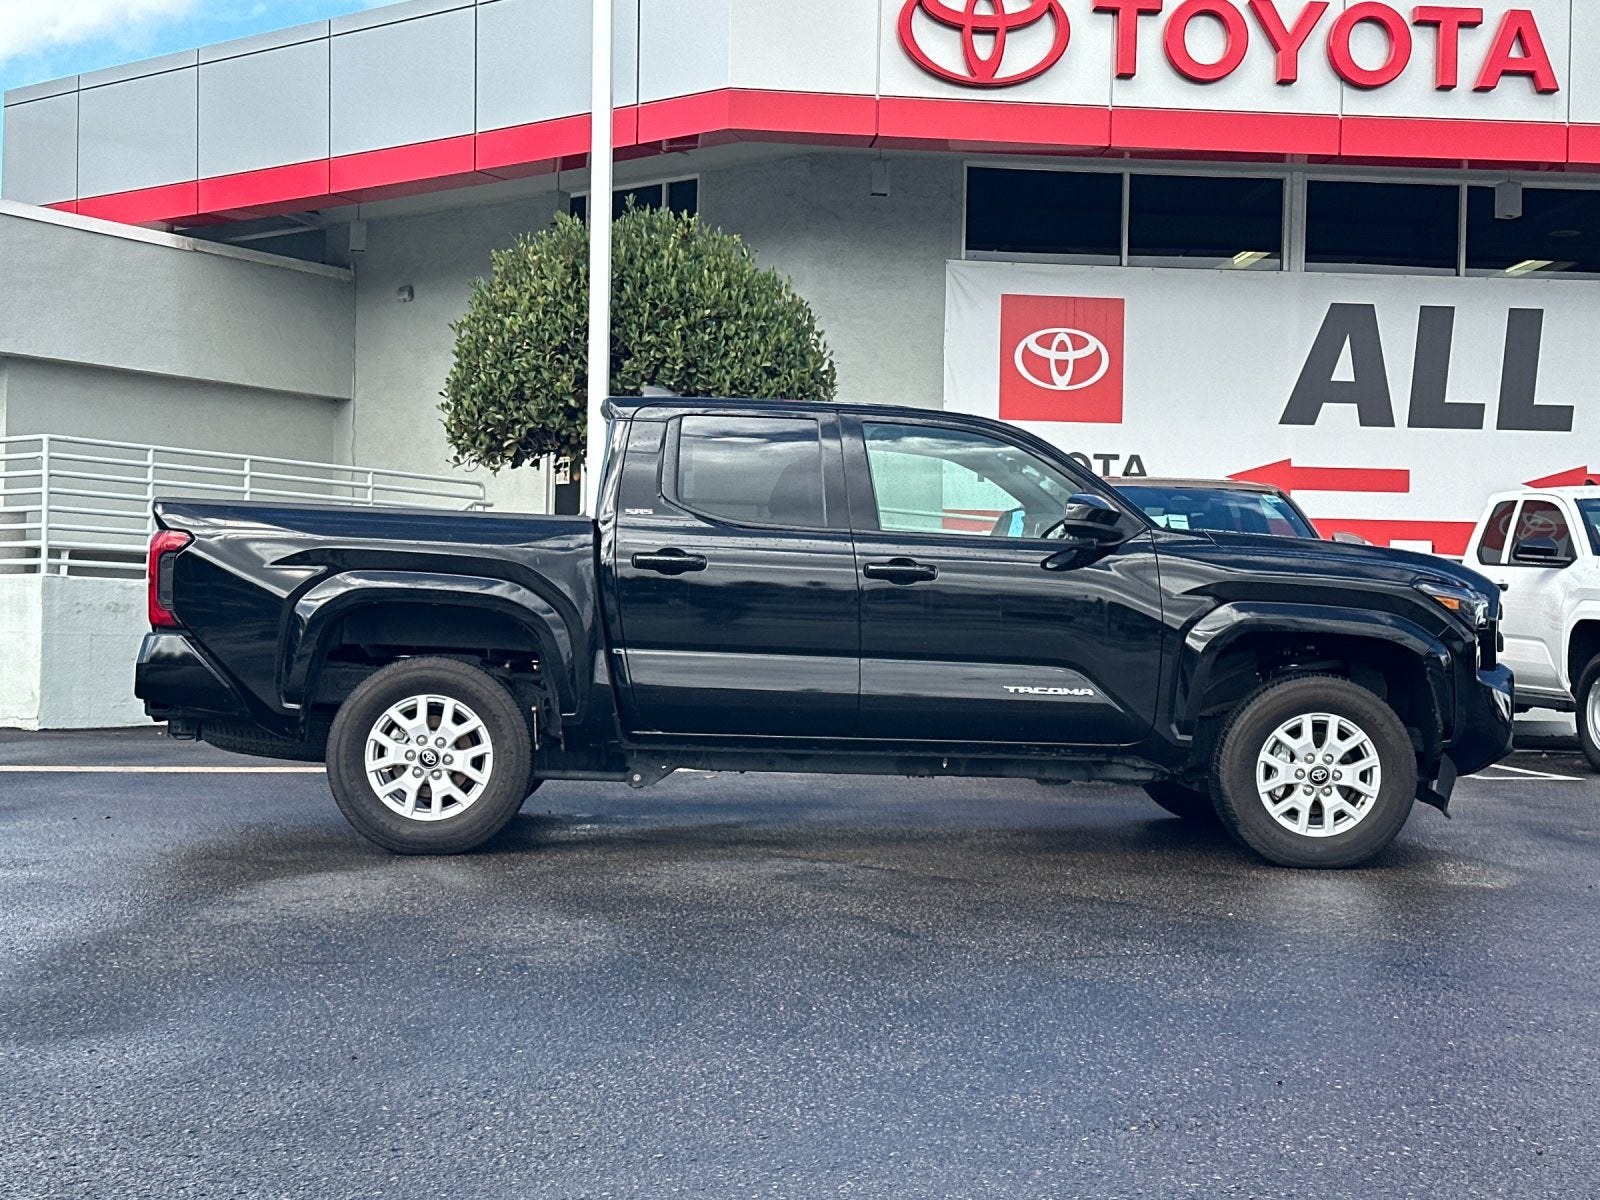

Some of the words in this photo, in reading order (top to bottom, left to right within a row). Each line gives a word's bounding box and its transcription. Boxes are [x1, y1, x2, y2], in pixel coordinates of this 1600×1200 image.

[1092, 0, 1560, 94] TOYOTA
[1278, 302, 1575, 433] ALL
[1003, 685, 1095, 697] TACOMA
